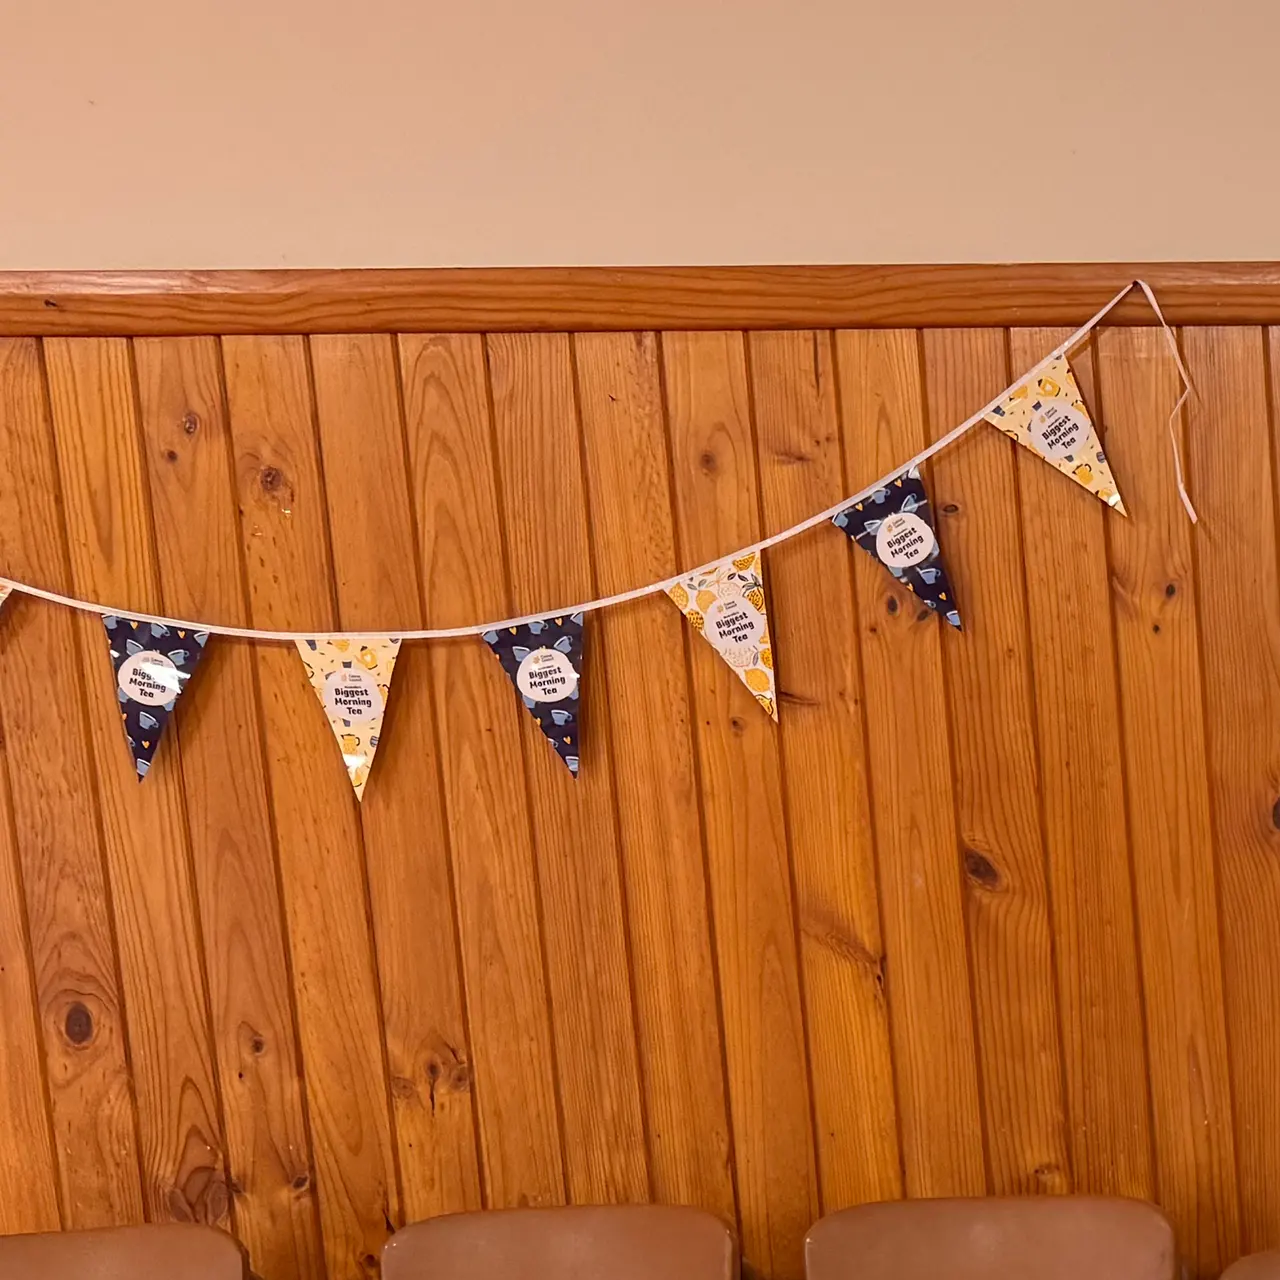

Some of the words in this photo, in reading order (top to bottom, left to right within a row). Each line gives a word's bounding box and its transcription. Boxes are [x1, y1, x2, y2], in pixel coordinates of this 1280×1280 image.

[1042, 415, 1071, 440] Biggest
[1047, 422, 1079, 450] Morning
[1061, 437, 1076, 449] Tea
[886, 527, 917, 548] Biggest
[890, 535, 924, 558] Morning
[904, 548, 919, 560] Tea
[716, 612, 748, 629] Biggest
[719, 621, 755, 639] Morning
[732, 633, 748, 643] Tea
[528, 667, 562, 679] Biggest
[129, 678, 166, 693] Morning
[530, 676, 566, 689] Morning
[139, 688, 154, 698] Tea
[334, 688, 369, 698] Biggest
[542, 688, 557, 696] Tea
[334, 698, 372, 708] Morning
[347, 707, 362, 715] Tea
